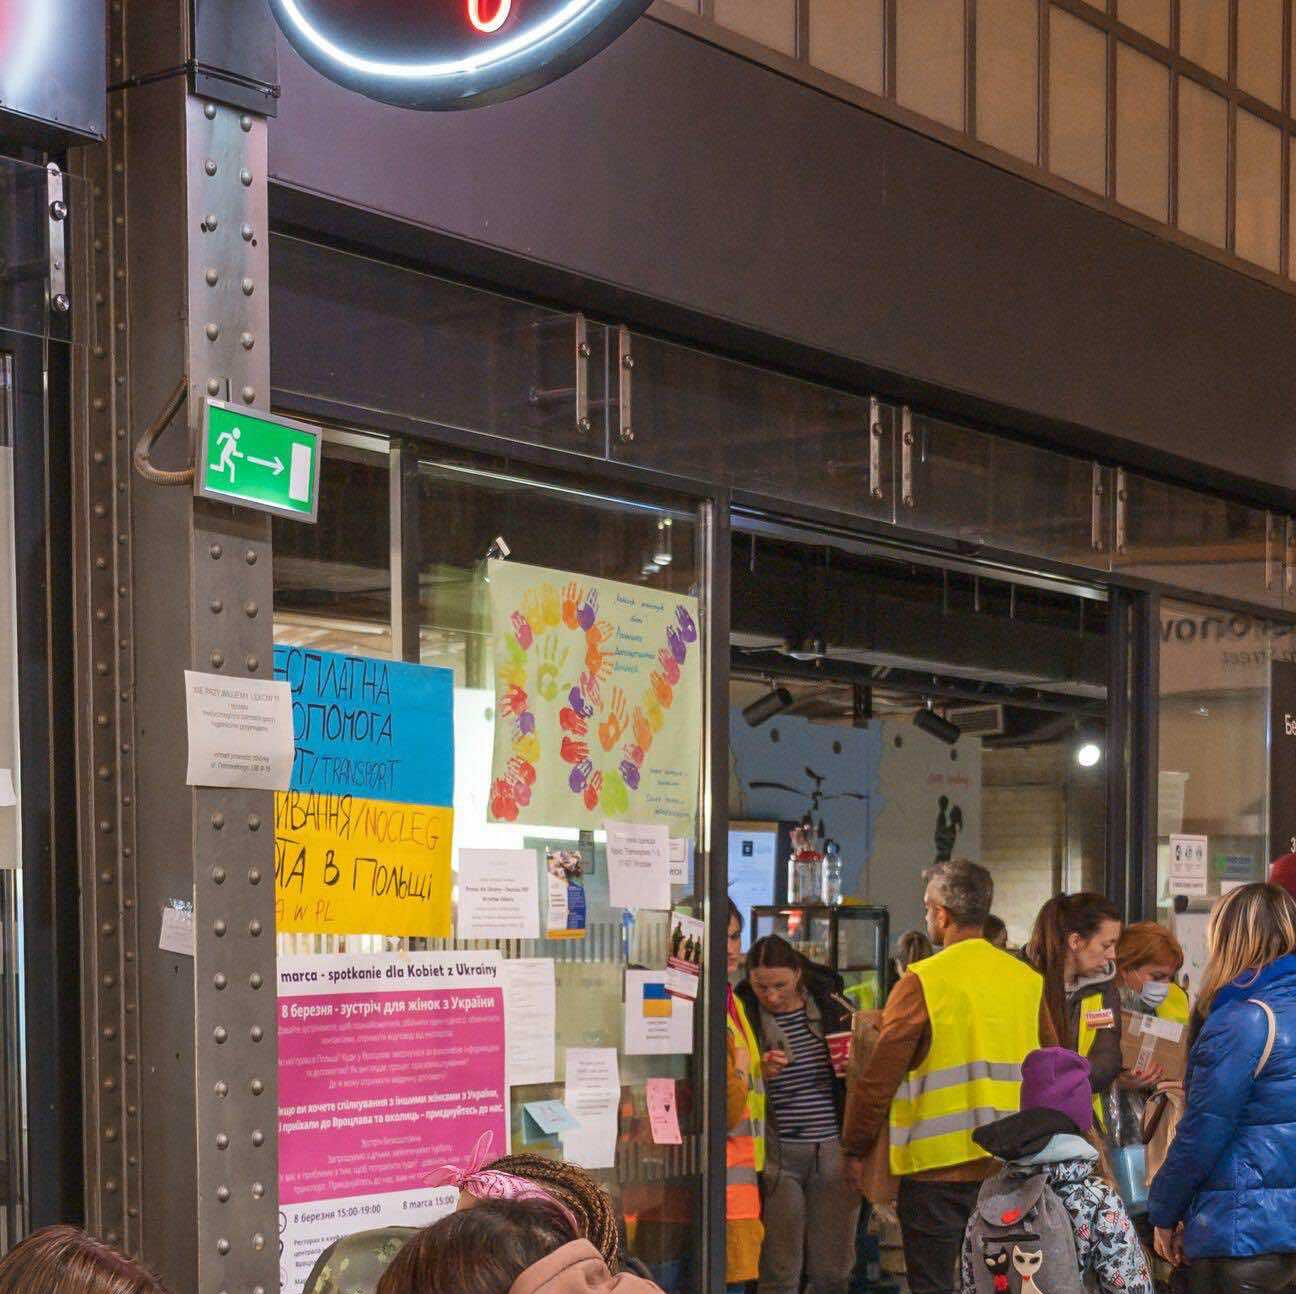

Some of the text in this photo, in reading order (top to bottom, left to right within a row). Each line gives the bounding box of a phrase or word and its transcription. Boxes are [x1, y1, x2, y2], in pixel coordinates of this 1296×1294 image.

[324, 850, 340, 885] В
[353, 857, 433, 901] ПОЛЬЩІ
[281, 971, 318, 982] marca
[328, 967, 382, 984] spotkanie
[386, 965, 404, 979] dla
[407, 964, 444, 978] Kobiet
[448, 967, 453, 976] z
[456, 963, 497, 979] Ukrainy
[282, 1006, 289, 1018] 8
[291, 1004, 333, 1020] березня
[341, 999, 381, 1018] зустріч
[384, 1000, 405, 1016] для
[408, 997, 440, 1012] жінок
[443, 999, 449, 1008] з
[451, 996, 495, 1013] України
[409, 1199, 433, 1209] marca
[294, 1213, 299, 1223] 8
[301, 1210, 336, 1225] березня
